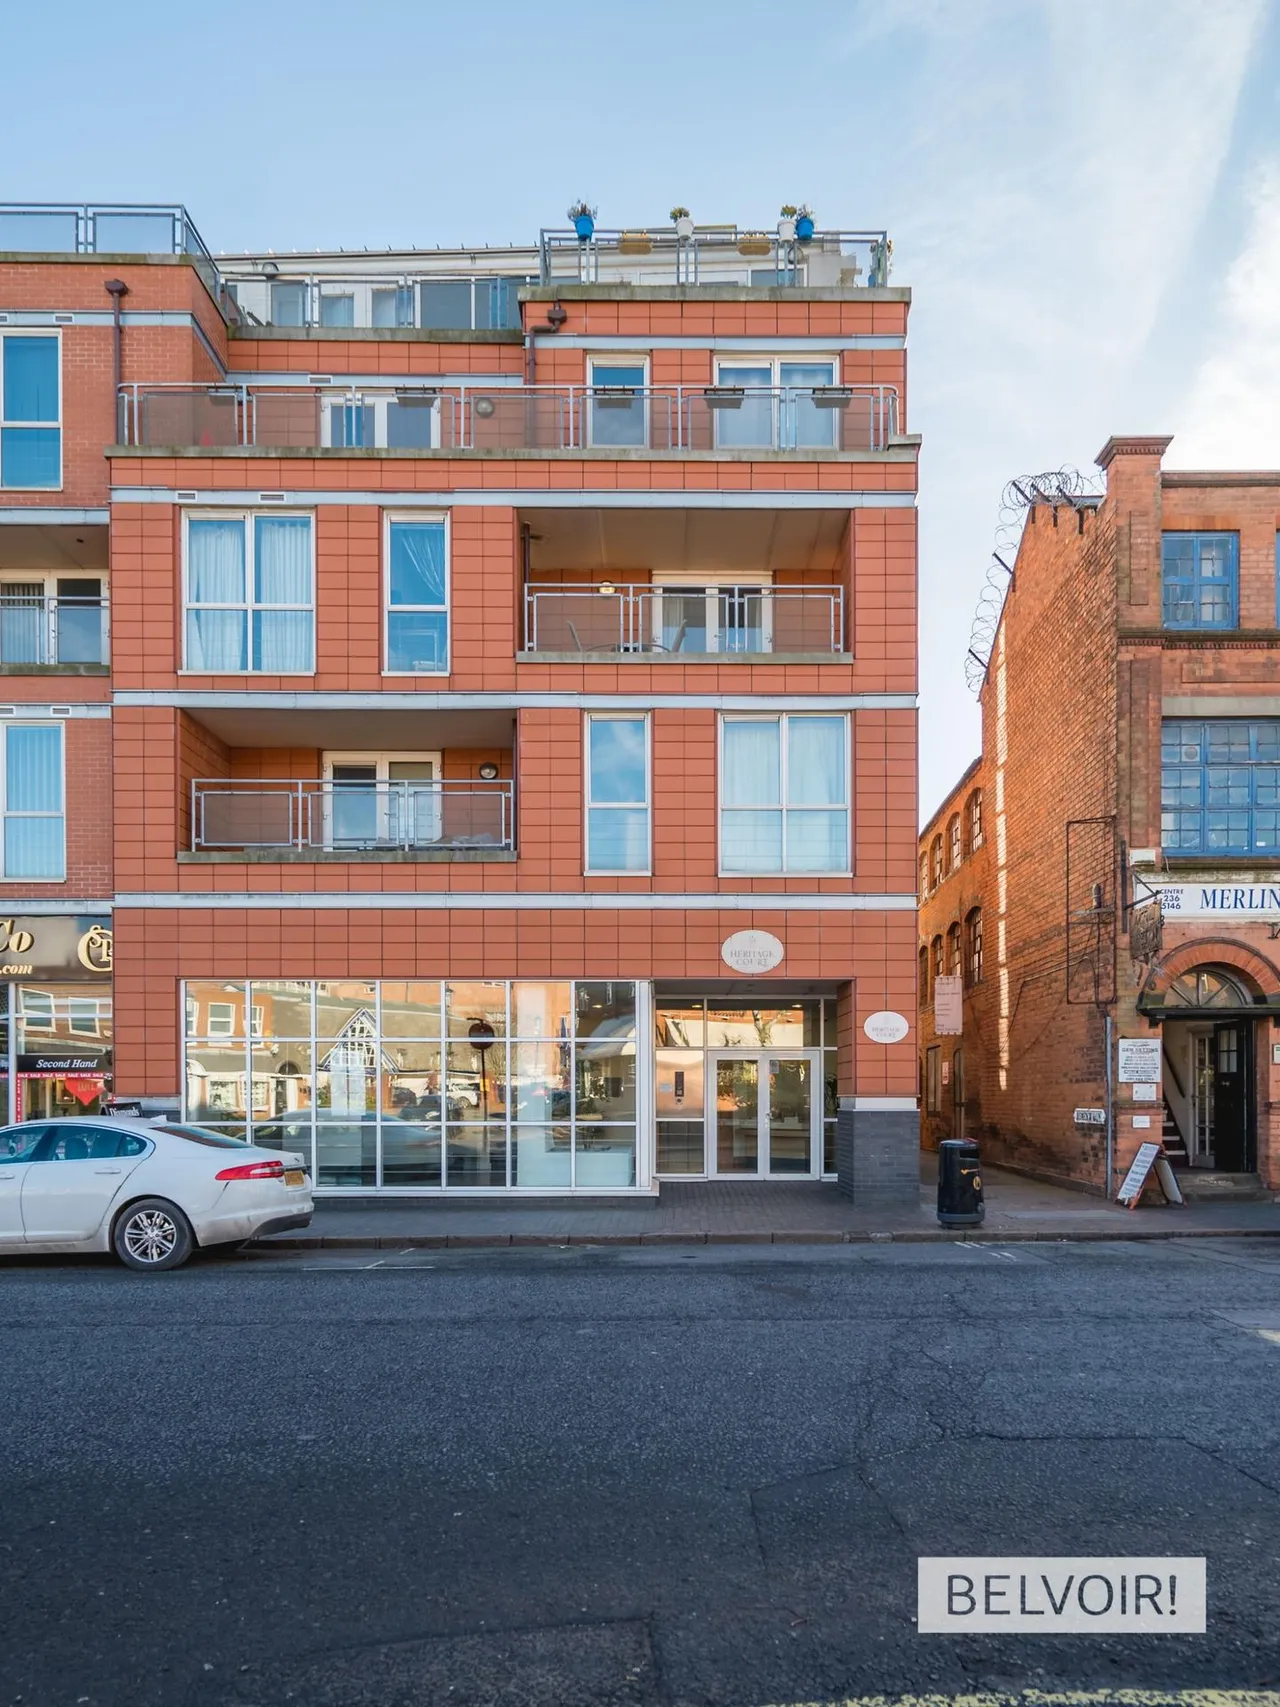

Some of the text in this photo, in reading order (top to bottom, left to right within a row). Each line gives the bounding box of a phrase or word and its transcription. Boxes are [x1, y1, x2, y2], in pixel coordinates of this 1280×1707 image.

[1161, 902, 1181, 910] 5146
[36, 1059, 98, 1069] Second Hand
